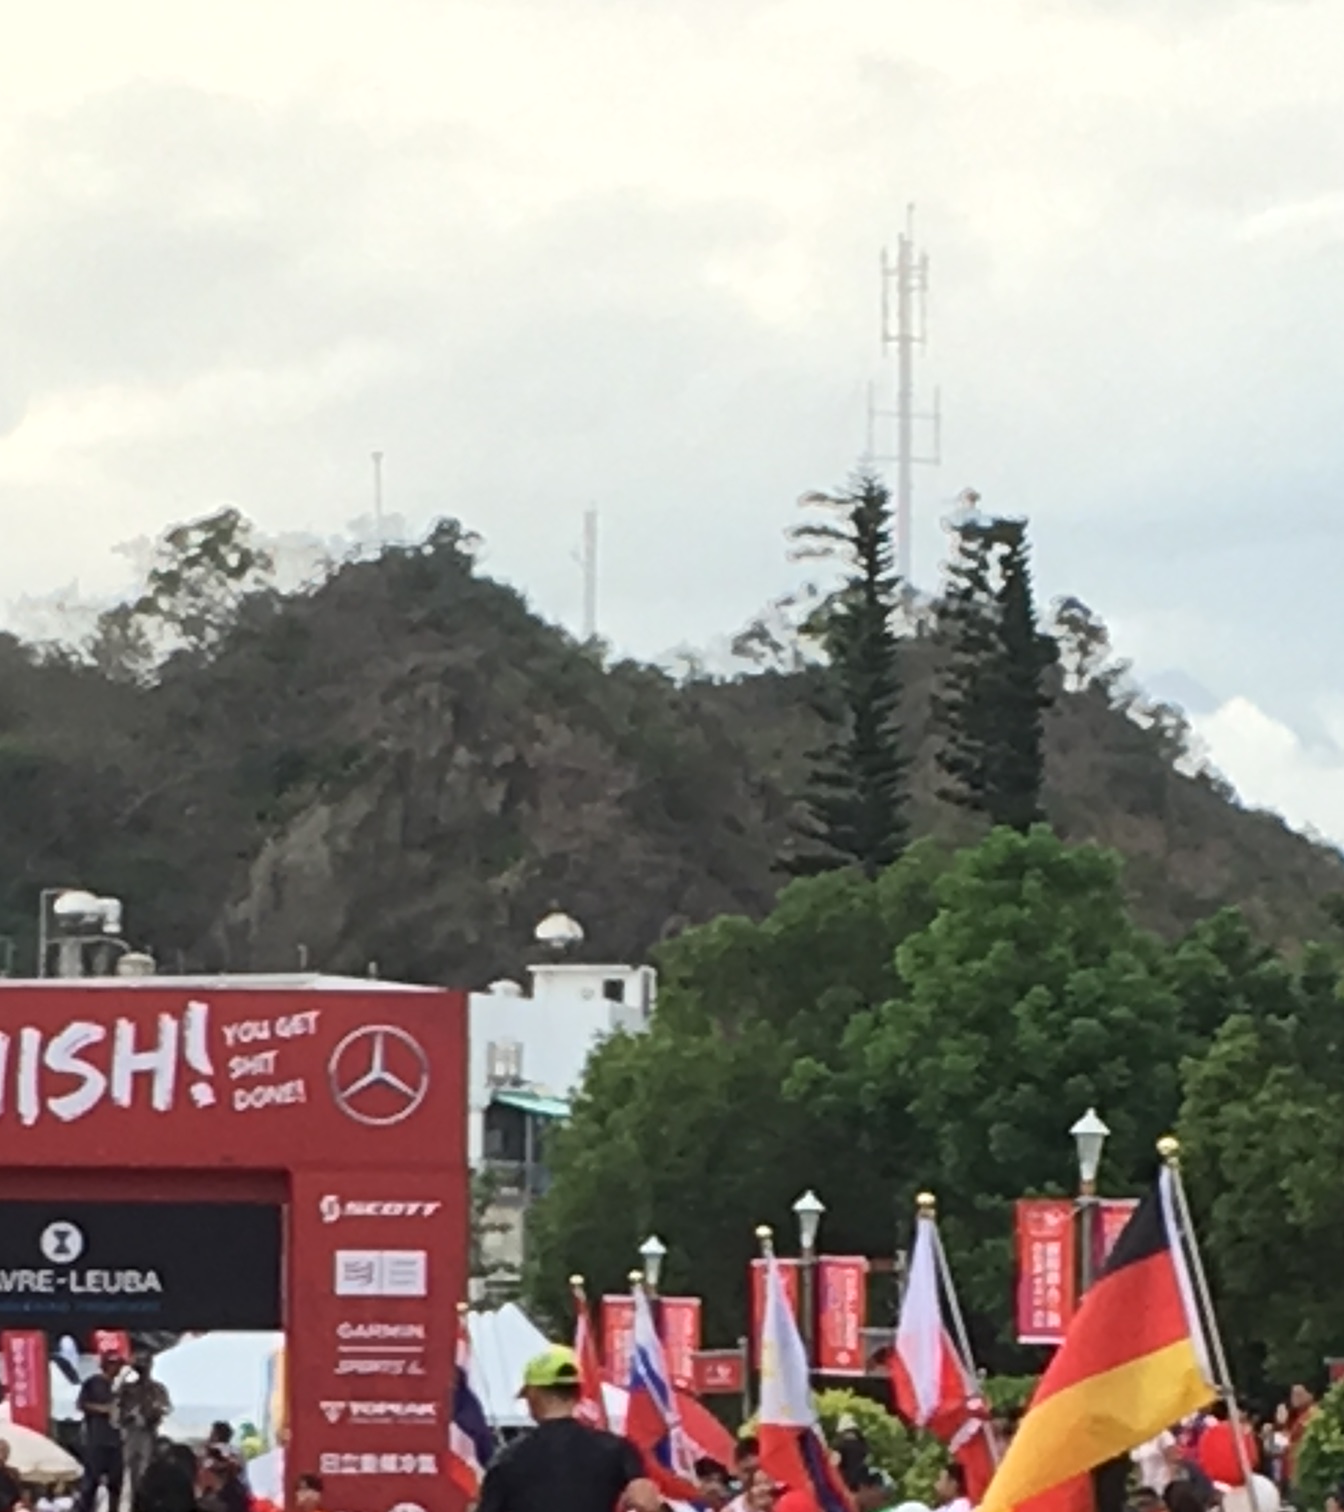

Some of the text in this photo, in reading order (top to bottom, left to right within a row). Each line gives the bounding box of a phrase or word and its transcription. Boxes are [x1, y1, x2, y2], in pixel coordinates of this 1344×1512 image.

[222, 1010, 322, 1047] YOU GET
[227, 1049, 280, 1080] SHIT
[233, 1079, 307, 1112] DONE!
